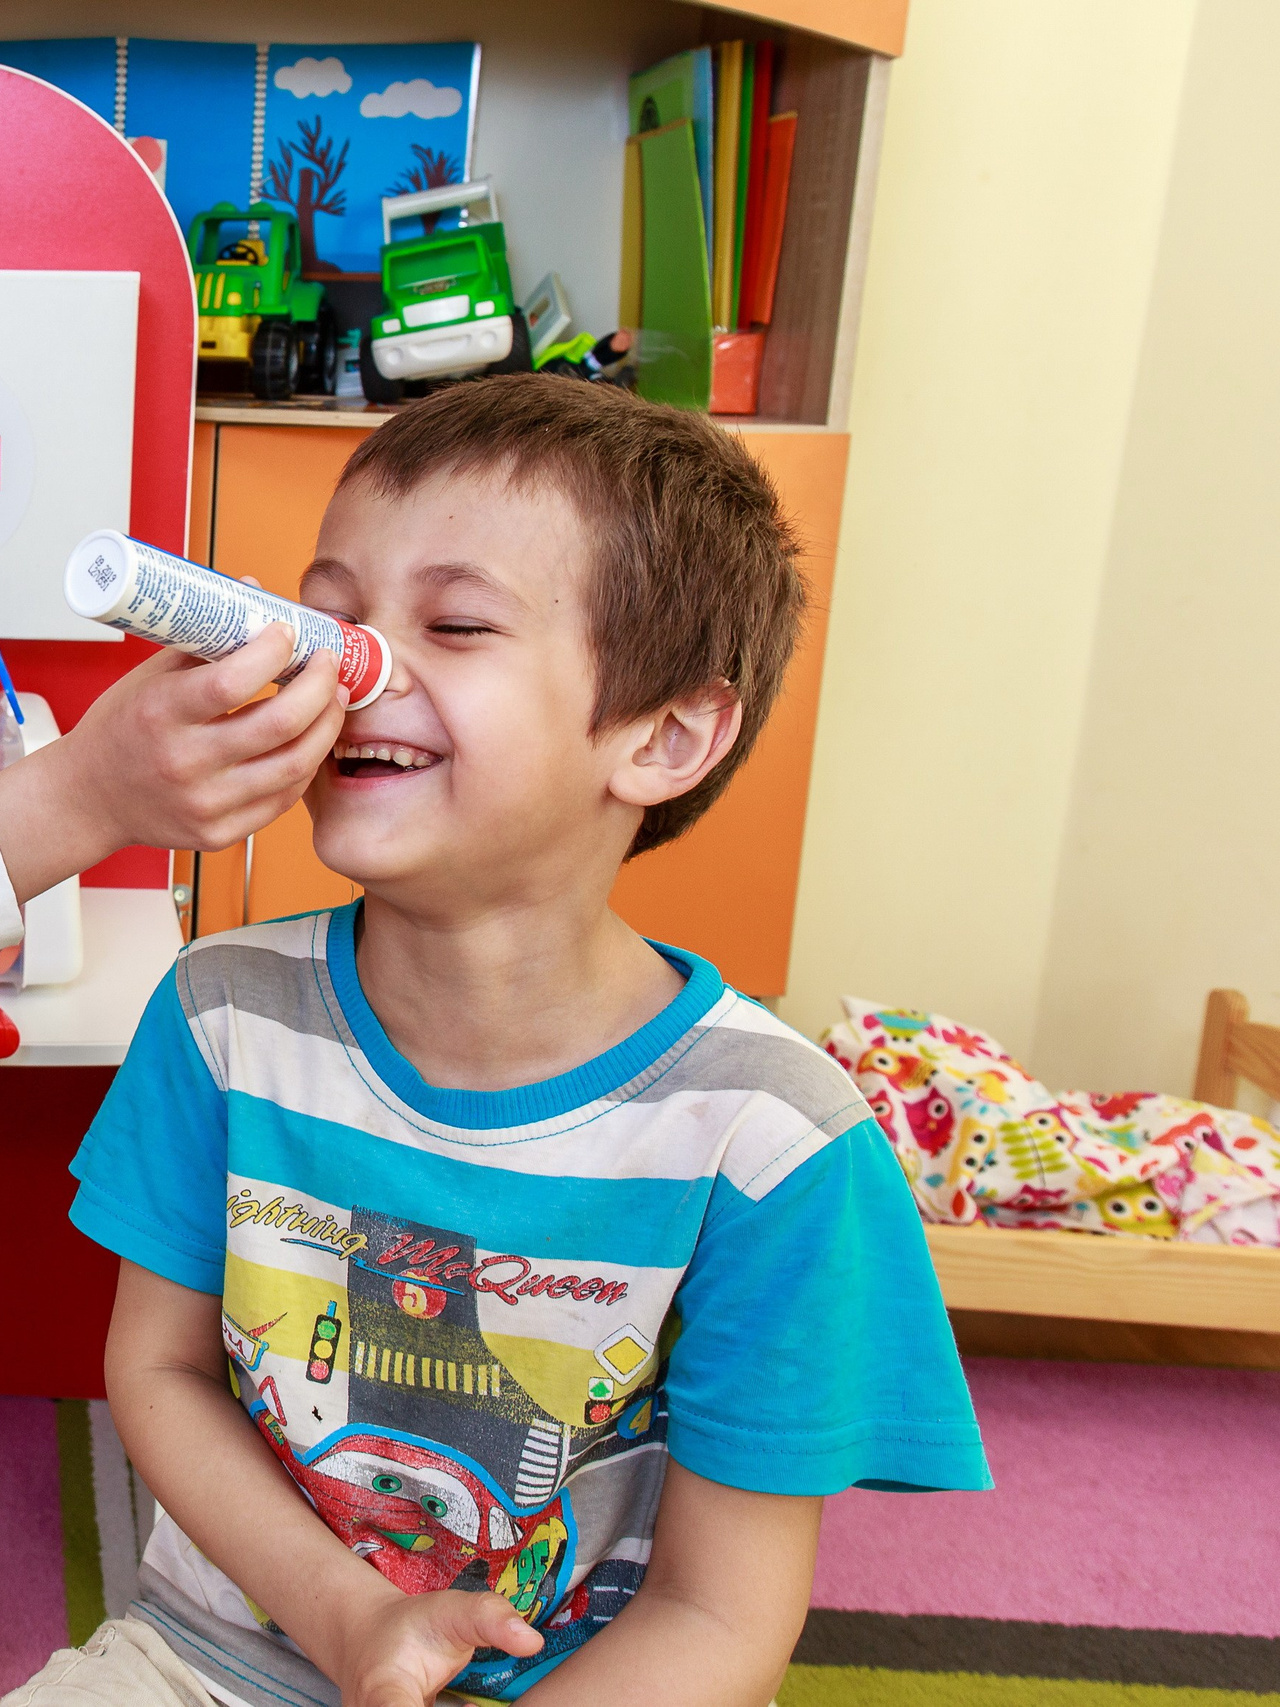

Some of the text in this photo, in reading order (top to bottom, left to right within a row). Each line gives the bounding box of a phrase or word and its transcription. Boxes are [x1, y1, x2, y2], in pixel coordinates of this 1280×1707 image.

[344, 634, 353, 647] 90
[345, 647, 352, 655] g
[342, 642, 361, 683] Tabletten
[226, 1189, 629, 1306] ightning McQueen
[628, 1398, 653, 1435] 4
